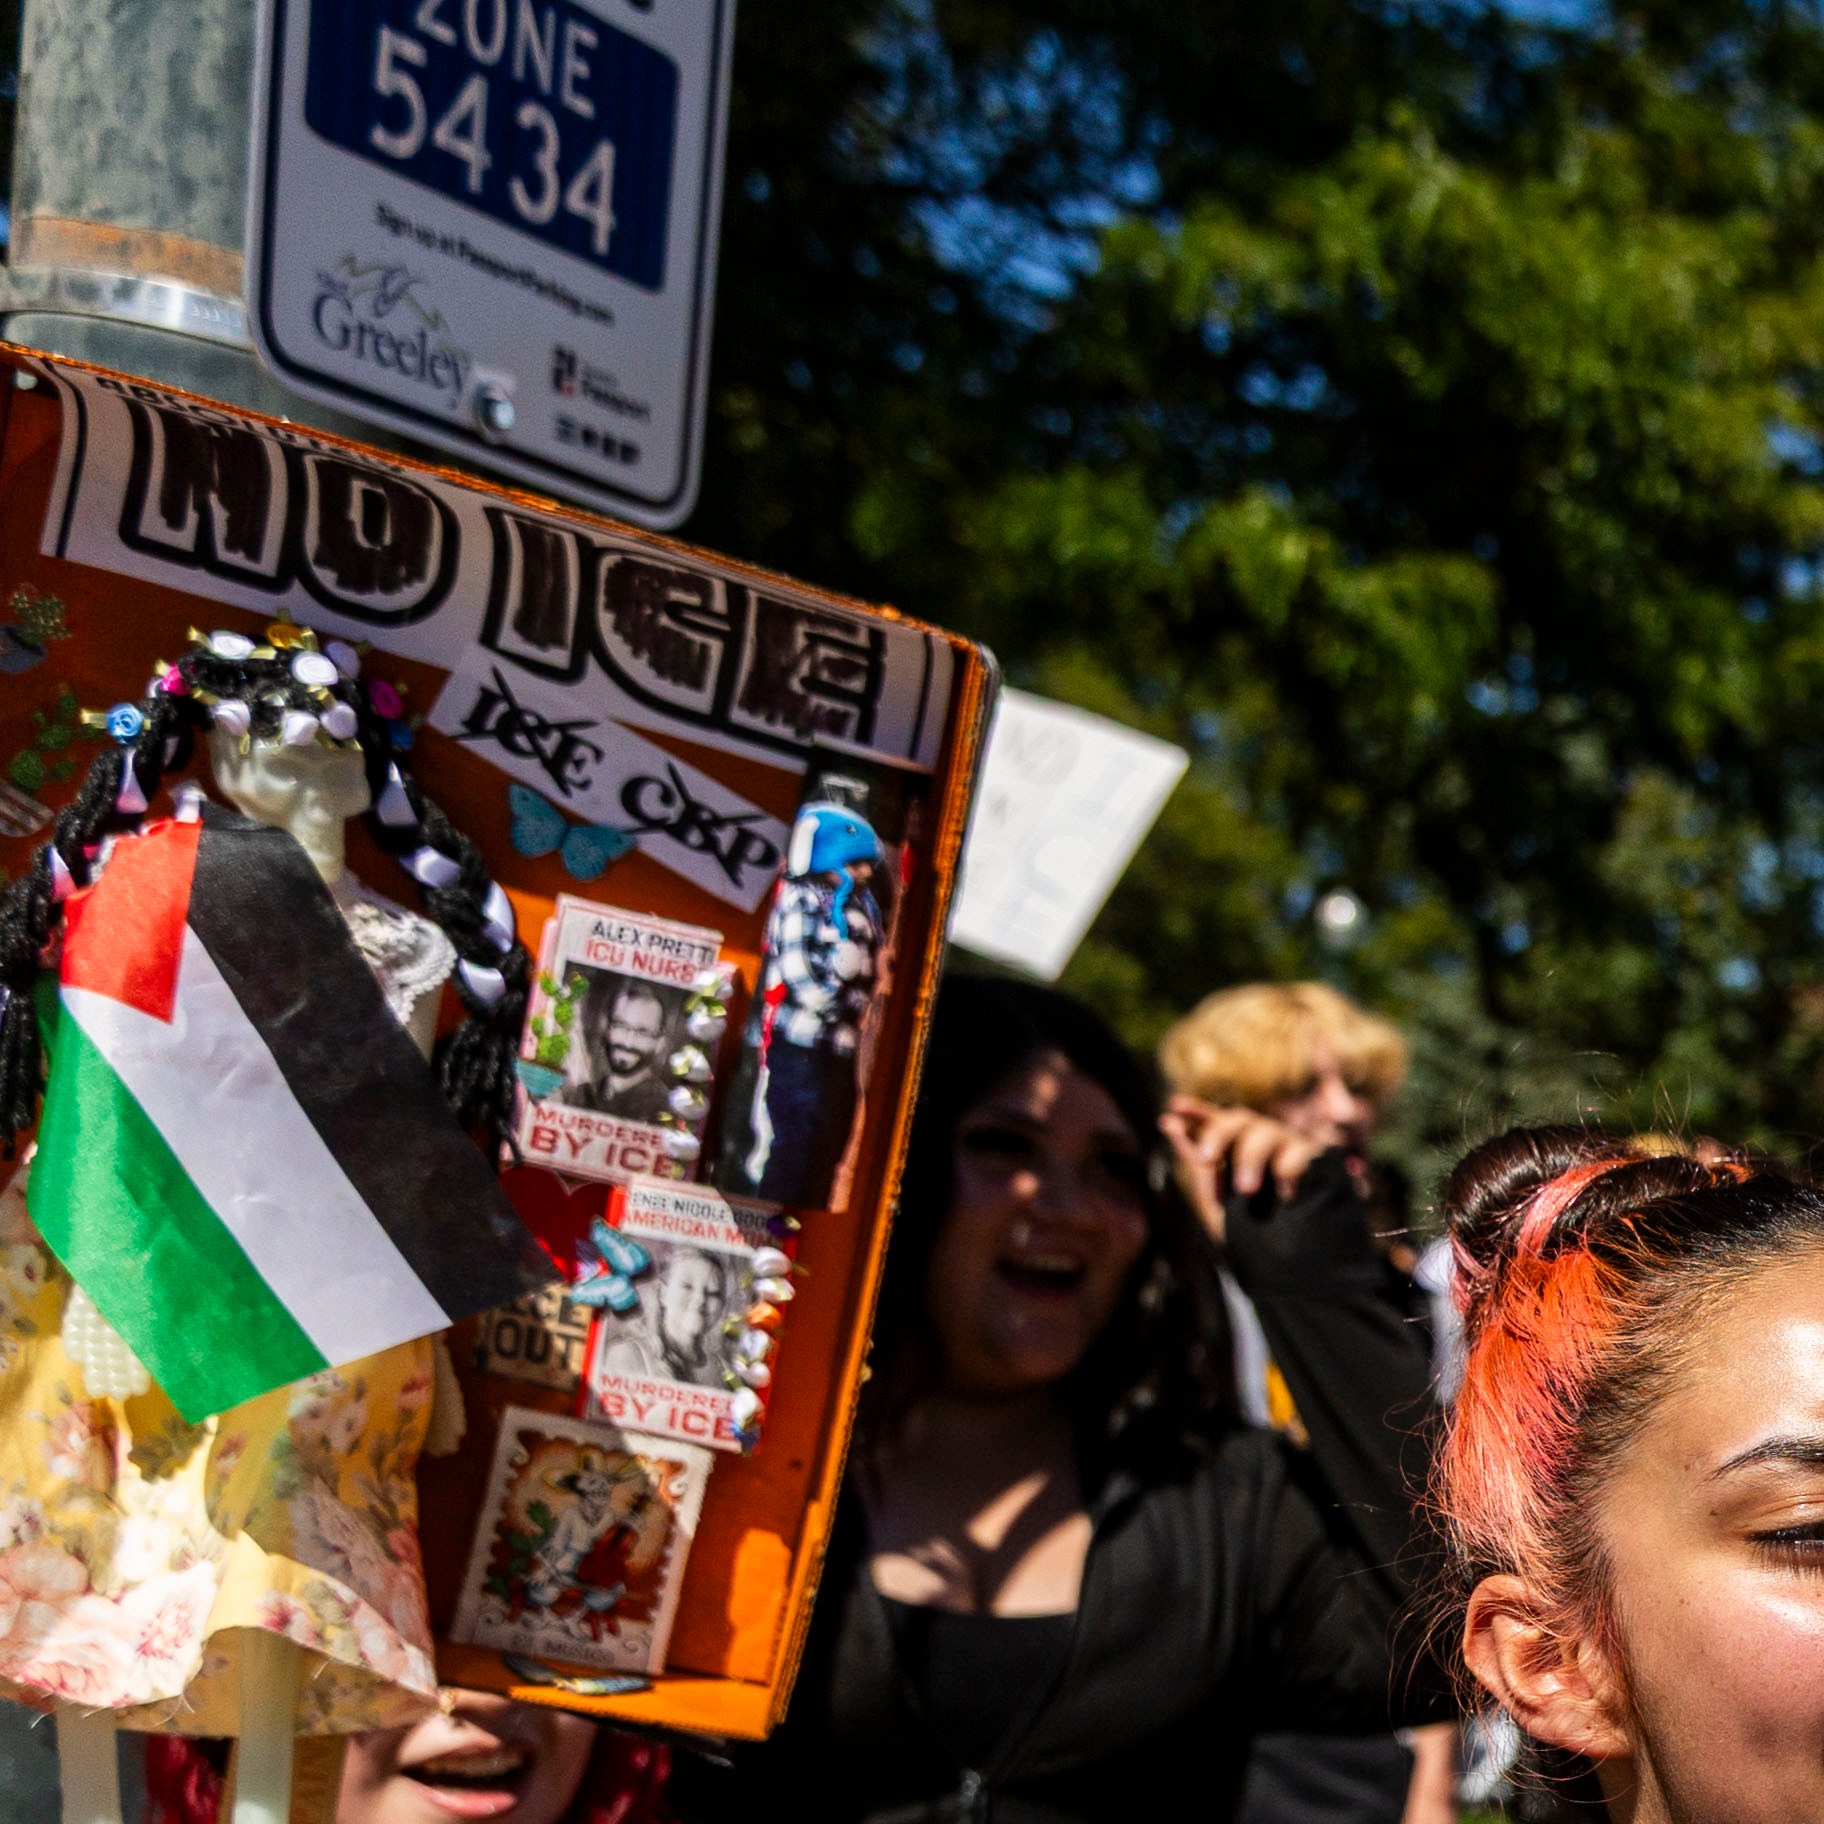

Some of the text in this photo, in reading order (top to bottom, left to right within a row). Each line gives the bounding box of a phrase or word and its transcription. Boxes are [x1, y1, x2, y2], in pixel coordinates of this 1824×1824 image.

[368, 22, 617, 257] 5434
[118, 398, 888, 757] NO ICE
[591, 919, 643, 945] ALEX
[584, 937, 697, 984] ICU NURS
[534, 1106, 662, 1147] MURDERE
[529, 1126, 678, 1180] BY ICE
[600, 1373, 732, 1410] MURDERE
[600, 1391, 738, 1443] BY ICE
